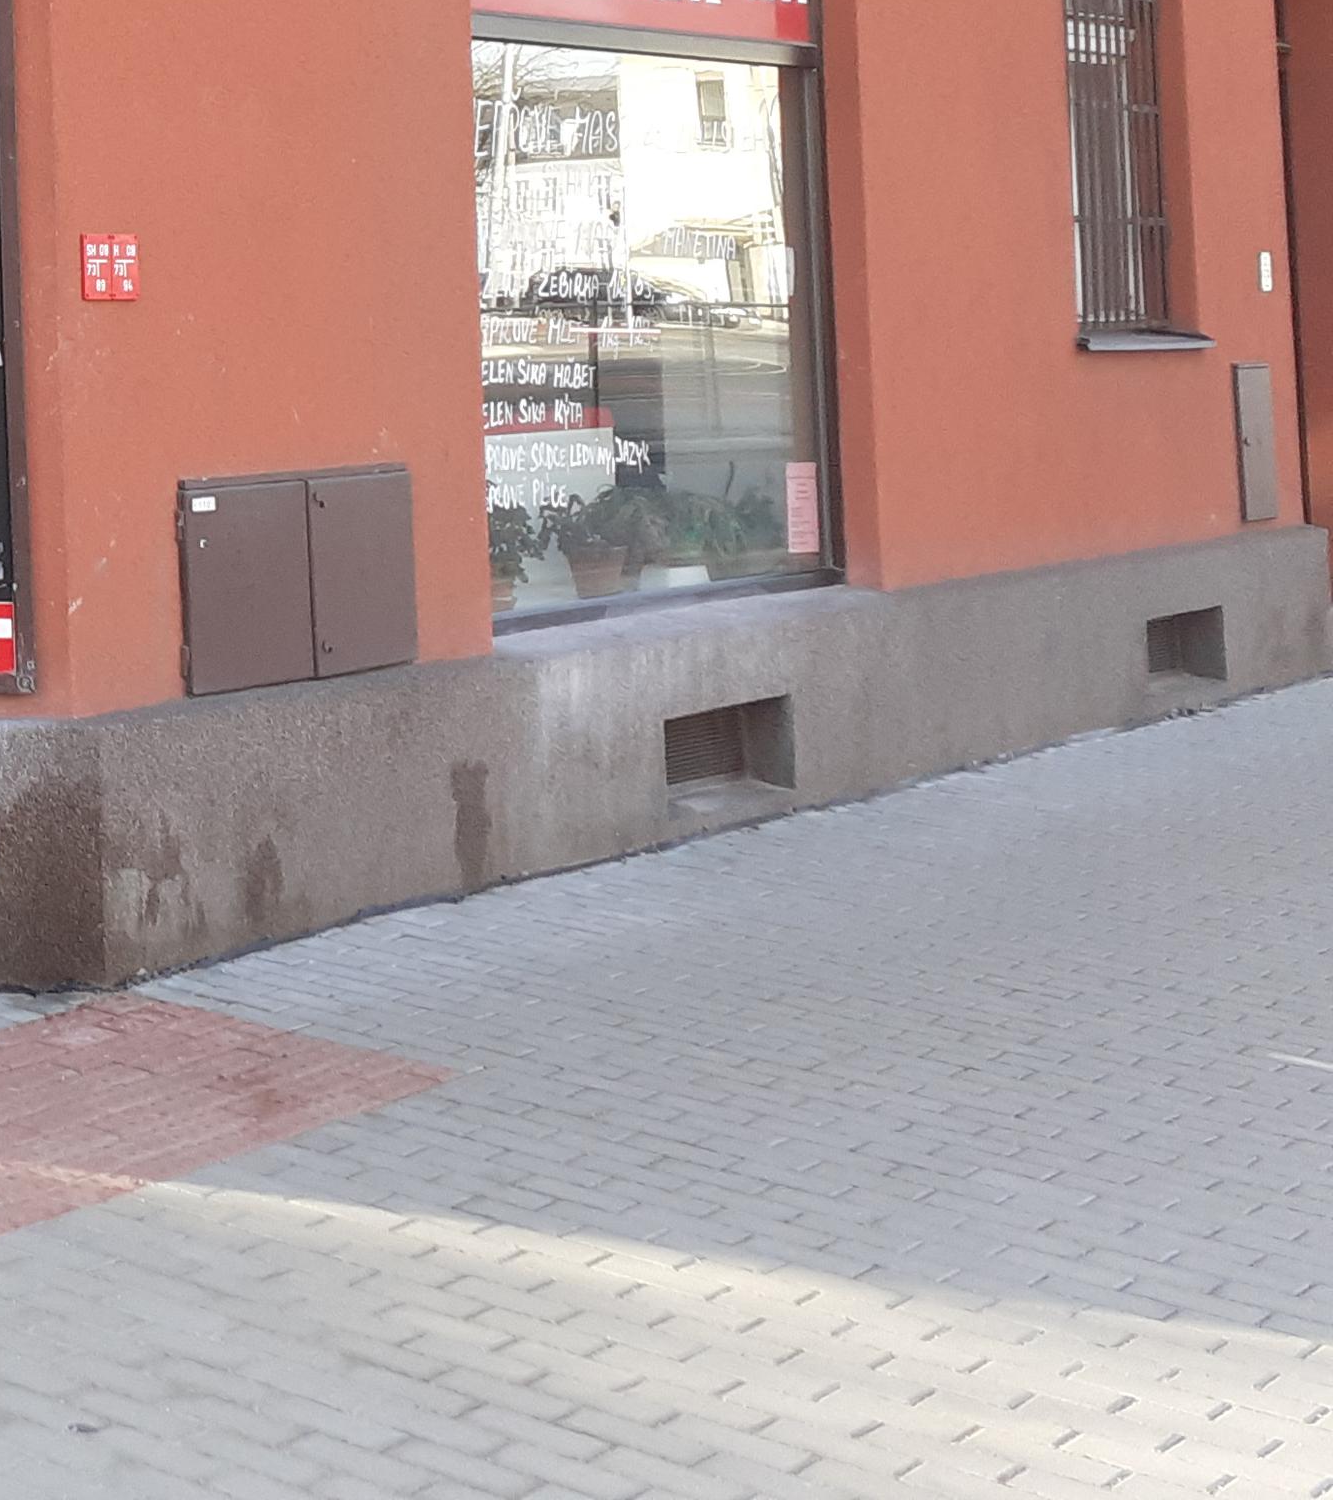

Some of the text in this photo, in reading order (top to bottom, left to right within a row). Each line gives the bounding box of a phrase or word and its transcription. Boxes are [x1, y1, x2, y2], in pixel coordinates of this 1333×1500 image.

[481, 359, 515, 386] ELEN
[553, 356, 597, 389] HŘBET
[482, 400, 514, 429] ELEN
